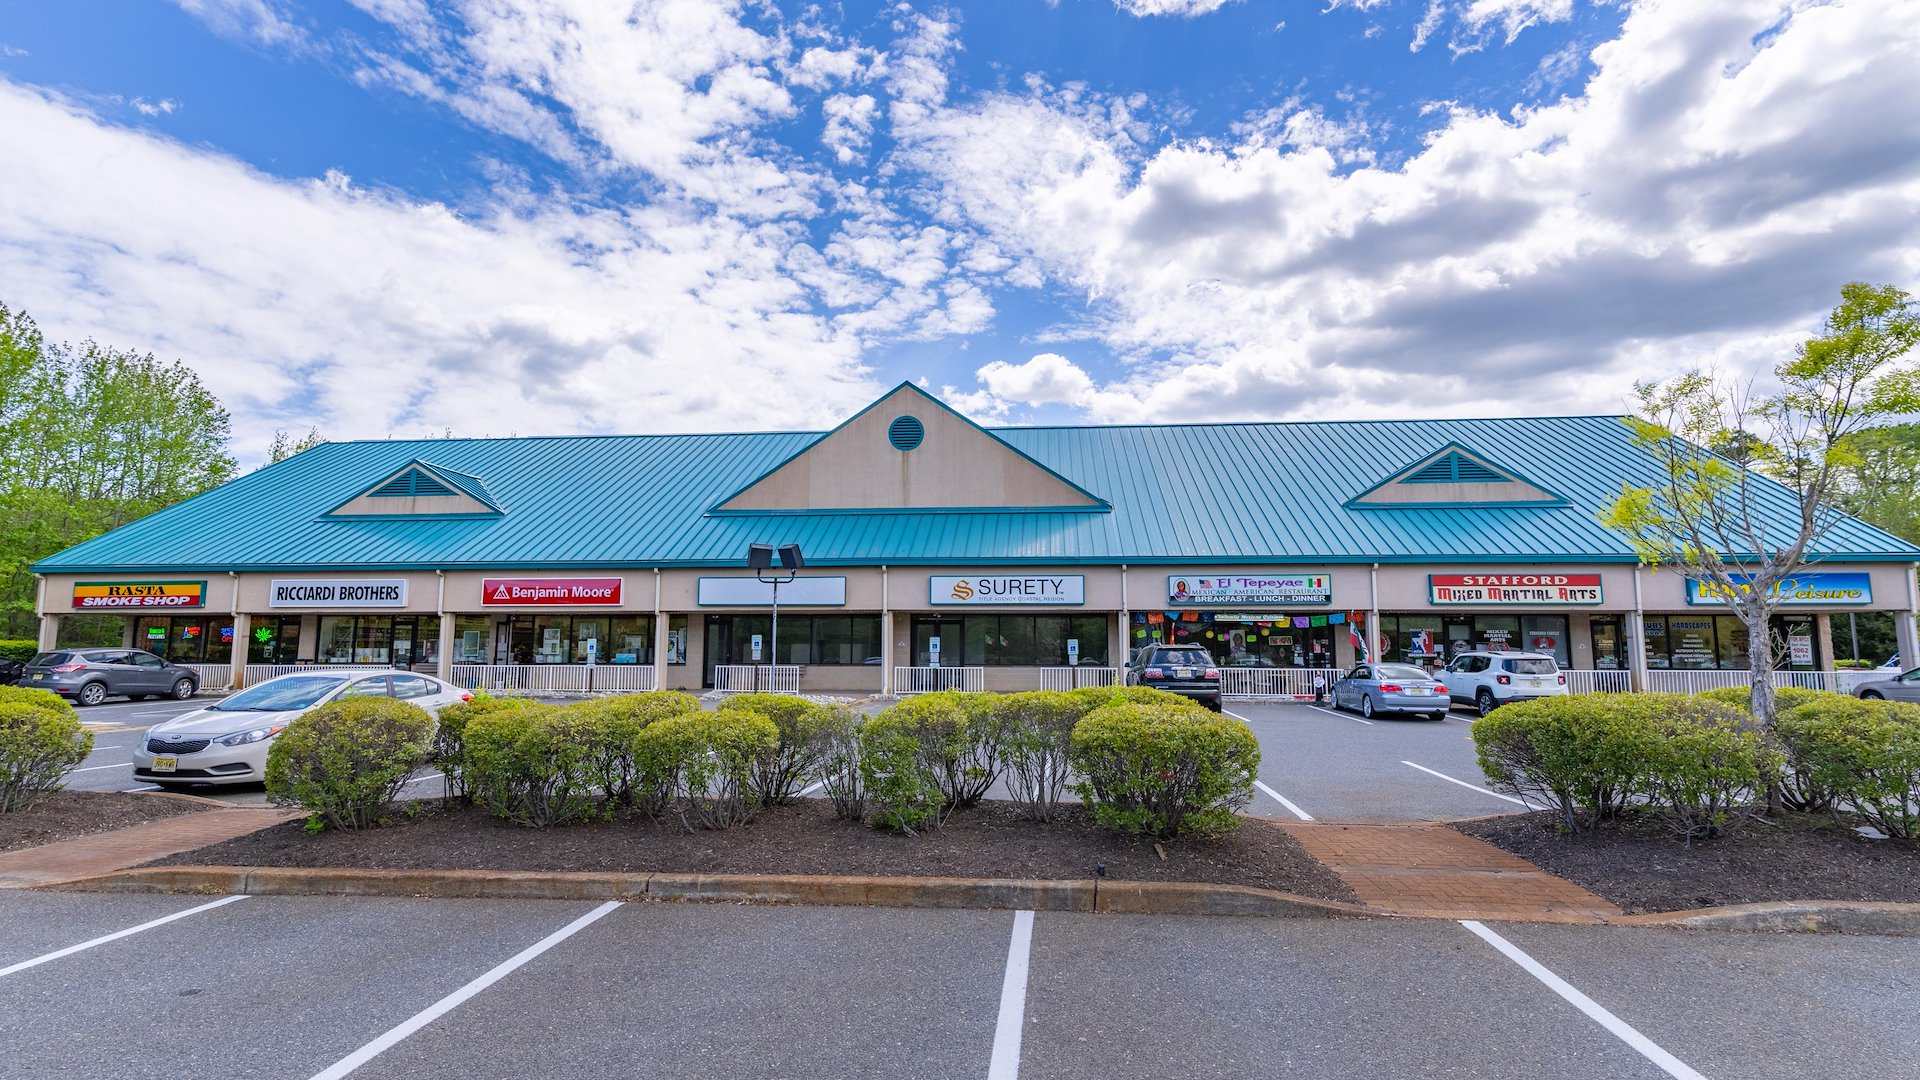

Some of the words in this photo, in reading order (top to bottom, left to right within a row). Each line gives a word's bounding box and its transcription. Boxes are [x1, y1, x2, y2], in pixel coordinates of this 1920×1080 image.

[978, 579, 1063, 595] SURETY
[1216, 578, 1231, 588] El
[1463, 576, 1569, 585] STAFFORD
[108, 585, 166, 596] RASTA
[276, 586, 336, 601] RICCIARDI
[339, 586, 399, 600] BROTHERS
[512, 586, 568, 601] Benjamin
[571, 586, 611, 598] Moore
[1437, 587, 1482, 602] MIXED
[1487, 587, 1553, 602] MARTIAL
[1558, 587, 1597, 602] ARTS
[1767, 578, 1862, 600] Leisure
[82, 597, 143, 606] SMOKE
[142, 596, 190, 605] SHOP
[1195, 595, 1247, 603] BREAKFAST
